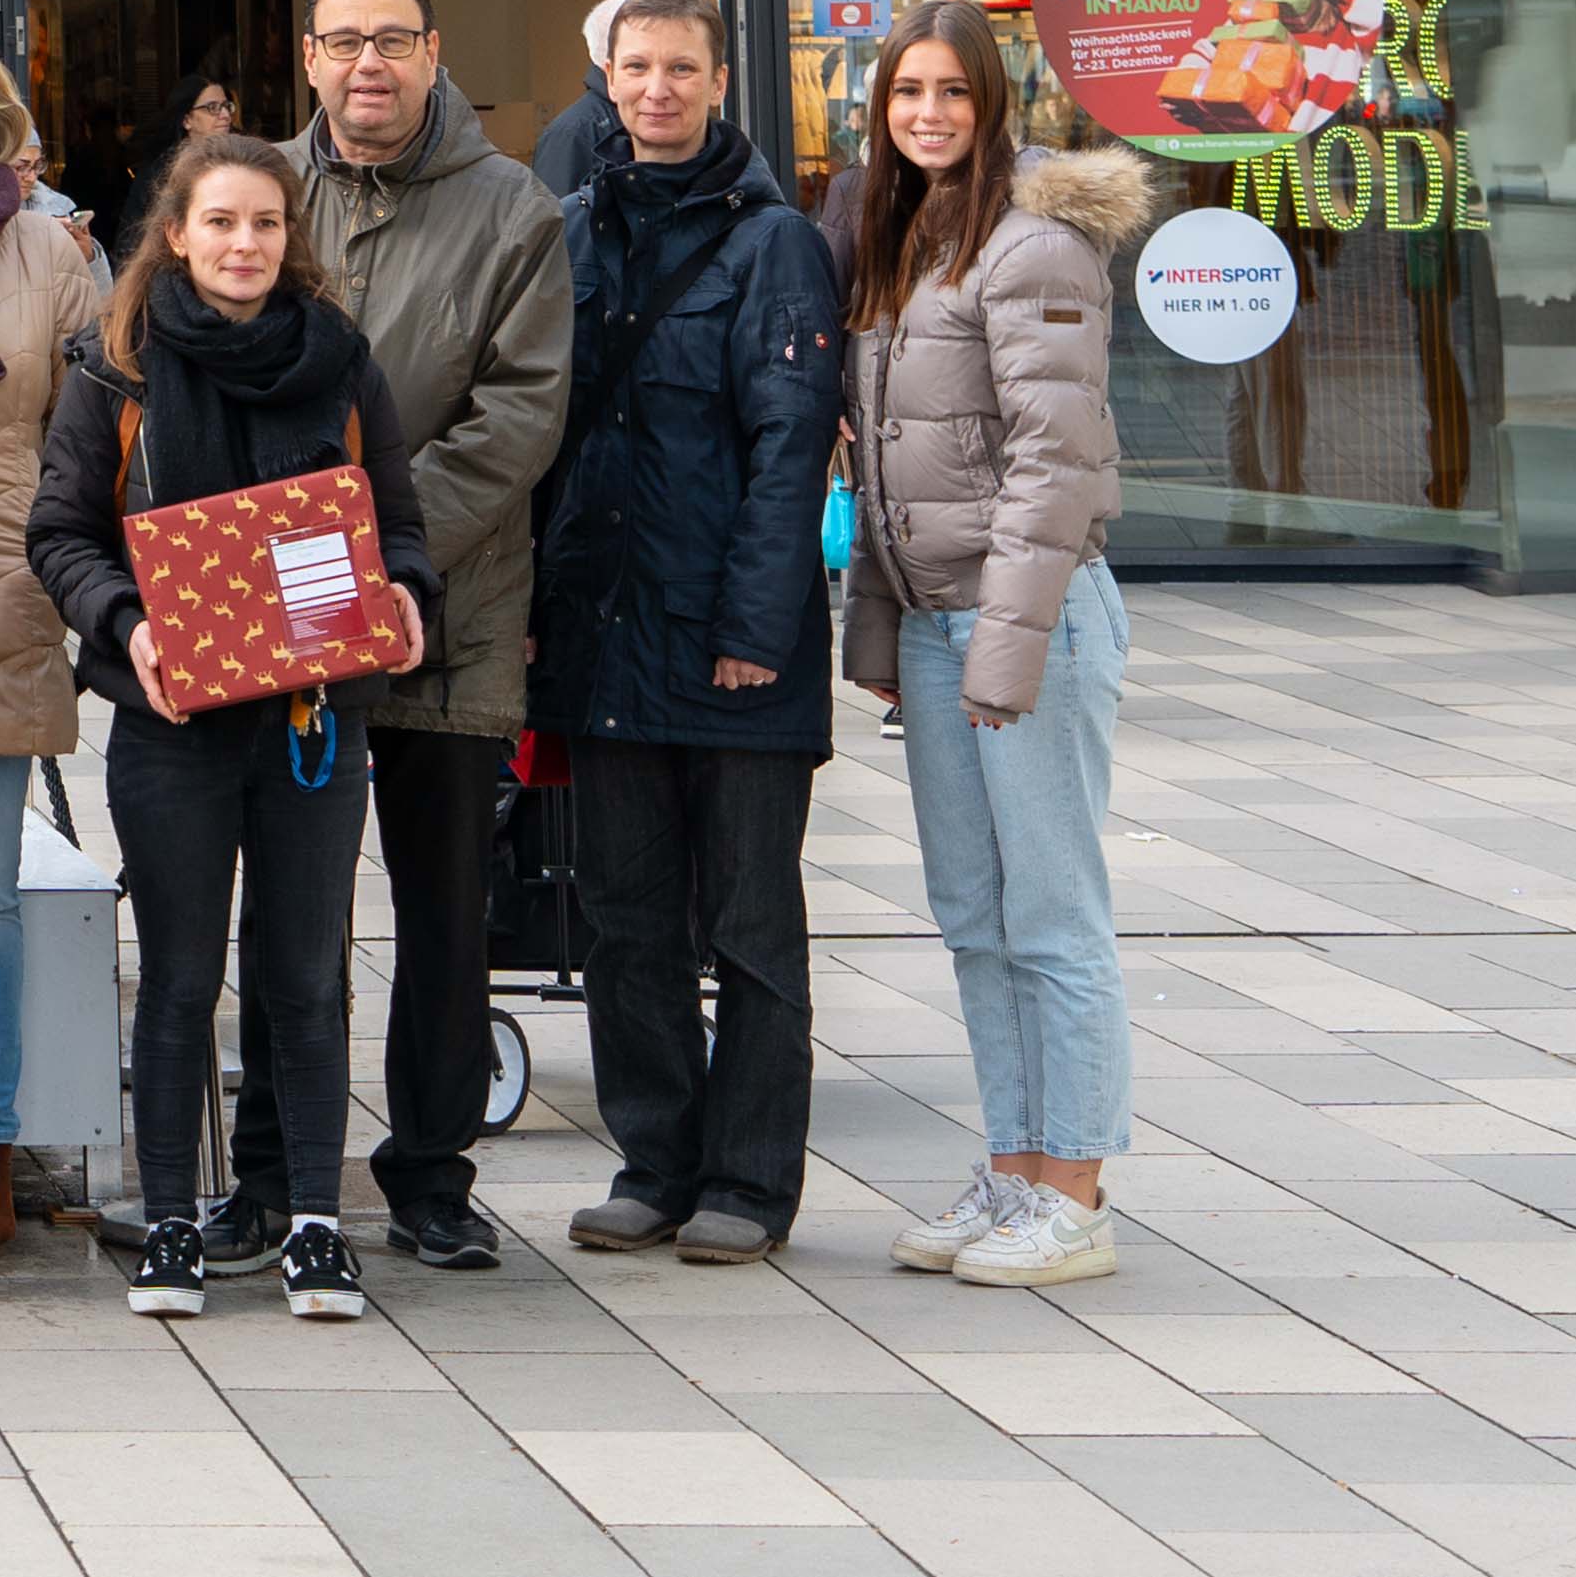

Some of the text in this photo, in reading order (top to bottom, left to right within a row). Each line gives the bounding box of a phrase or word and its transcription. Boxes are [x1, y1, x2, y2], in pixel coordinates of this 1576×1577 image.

[1070, 27, 1192, 48] Weihnachtsbäckerei
[1071, 43, 1163, 61] für Kinder vom
[1112, 53, 1175, 70] Dezember
[1166, 267, 1281, 283] INTERSPORT
[1164, 297, 1271, 312] HIER IM 1. OG
